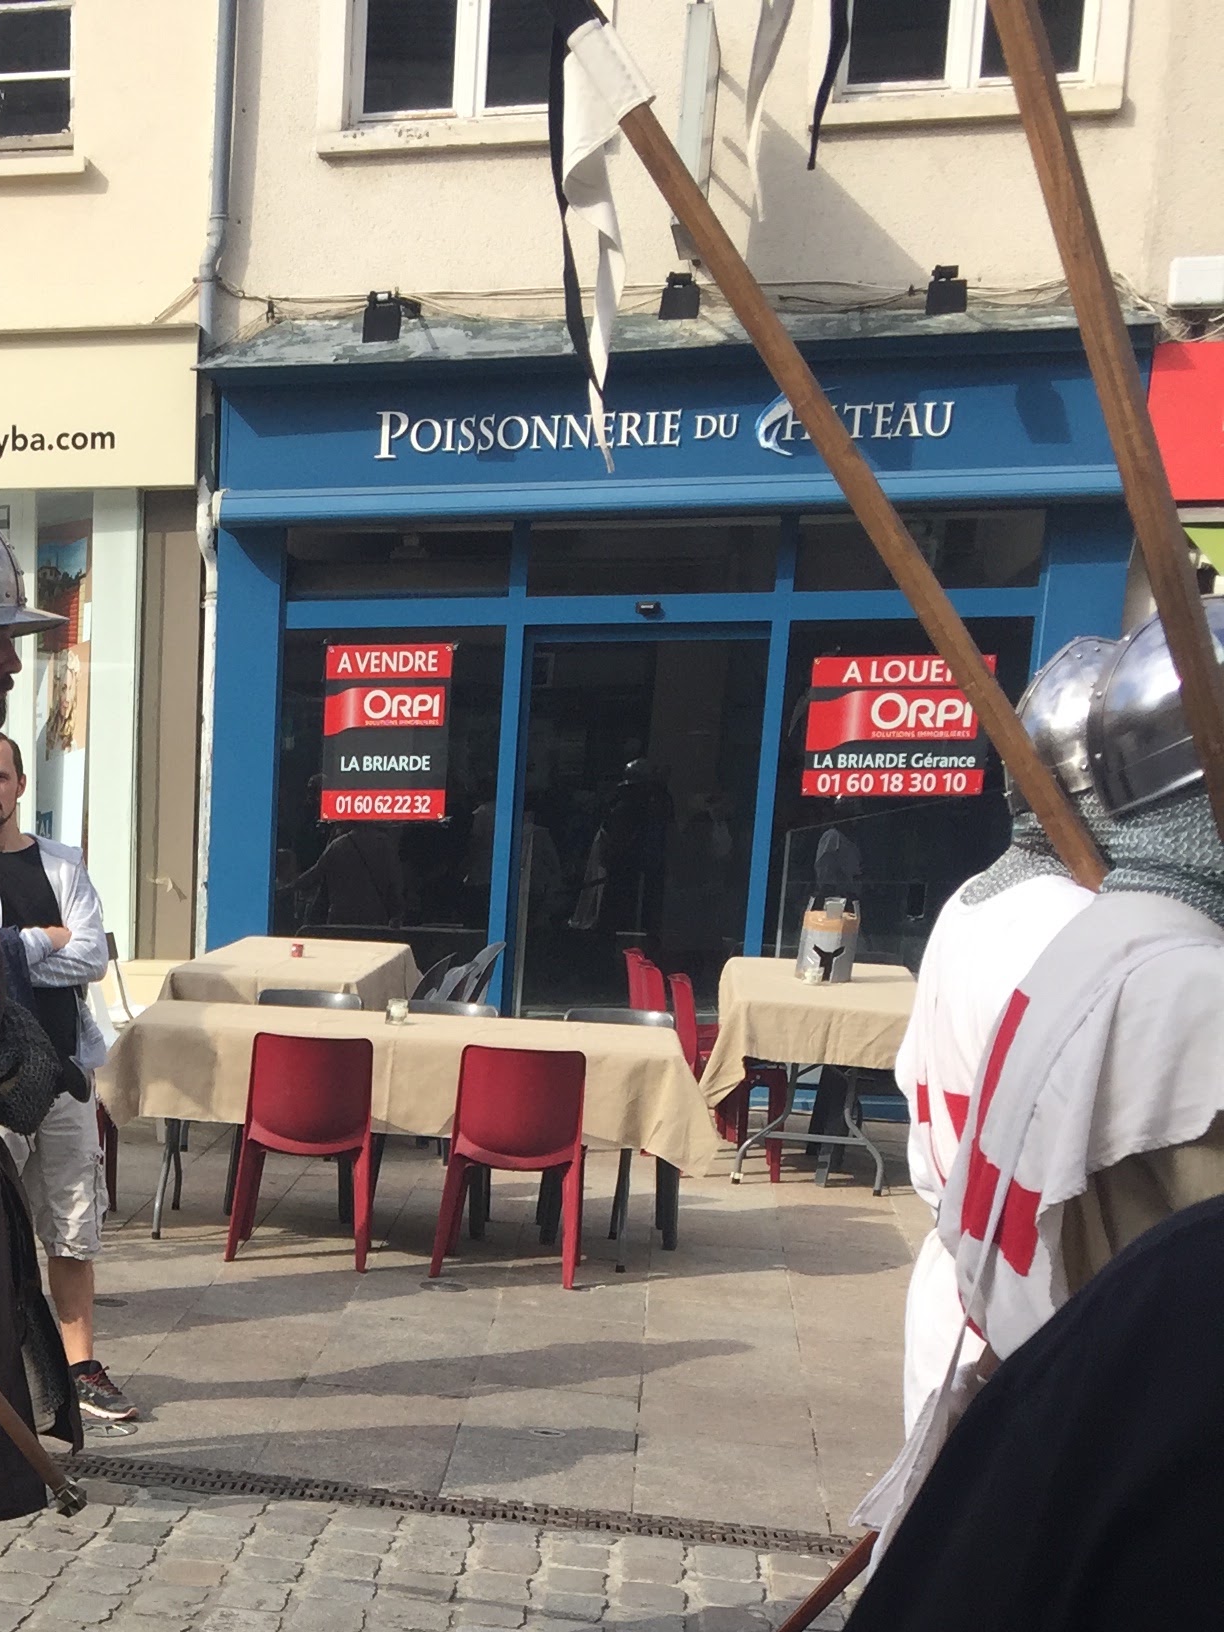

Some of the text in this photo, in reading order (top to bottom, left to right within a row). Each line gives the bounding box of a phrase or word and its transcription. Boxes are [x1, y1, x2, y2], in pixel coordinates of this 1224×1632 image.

[374, 408, 682, 460] POISSONNERIE
[693, 413, 739, 439] DU
[337, 651, 439, 673] A VENDRE
[842, 661, 863, 683] A
[363, 689, 440, 719] ORPI
[871, 692, 973, 730] ORPI
[871, 730, 915, 738] SOLUTIONS
[340, 755, 431, 772] LA BRIARDE
[813, 751, 976, 769] LA BRIARDE Gérance
[817, 772, 967, 793] 01 60 18 30 10
[336, 795, 431, 813] 01 60 62 22 32
